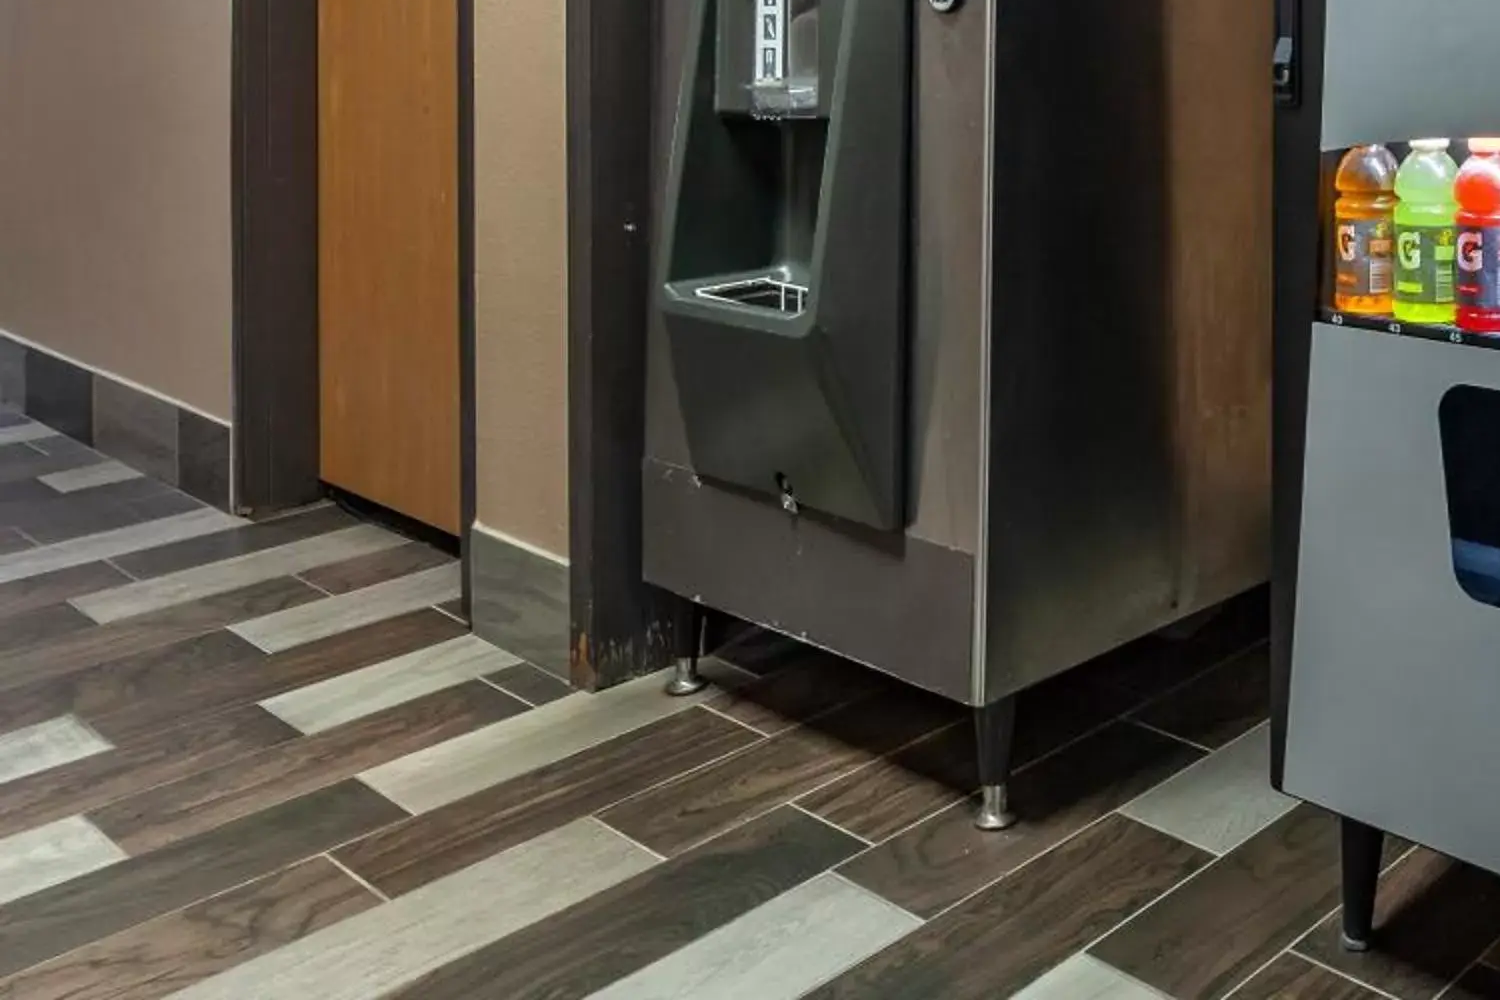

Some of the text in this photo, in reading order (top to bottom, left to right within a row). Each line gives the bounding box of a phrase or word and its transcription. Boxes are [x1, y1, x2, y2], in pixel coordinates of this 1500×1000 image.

[1338, 224, 1356, 261] G
[1398, 231, 1421, 270] G
[1457, 231, 1483, 272] G
